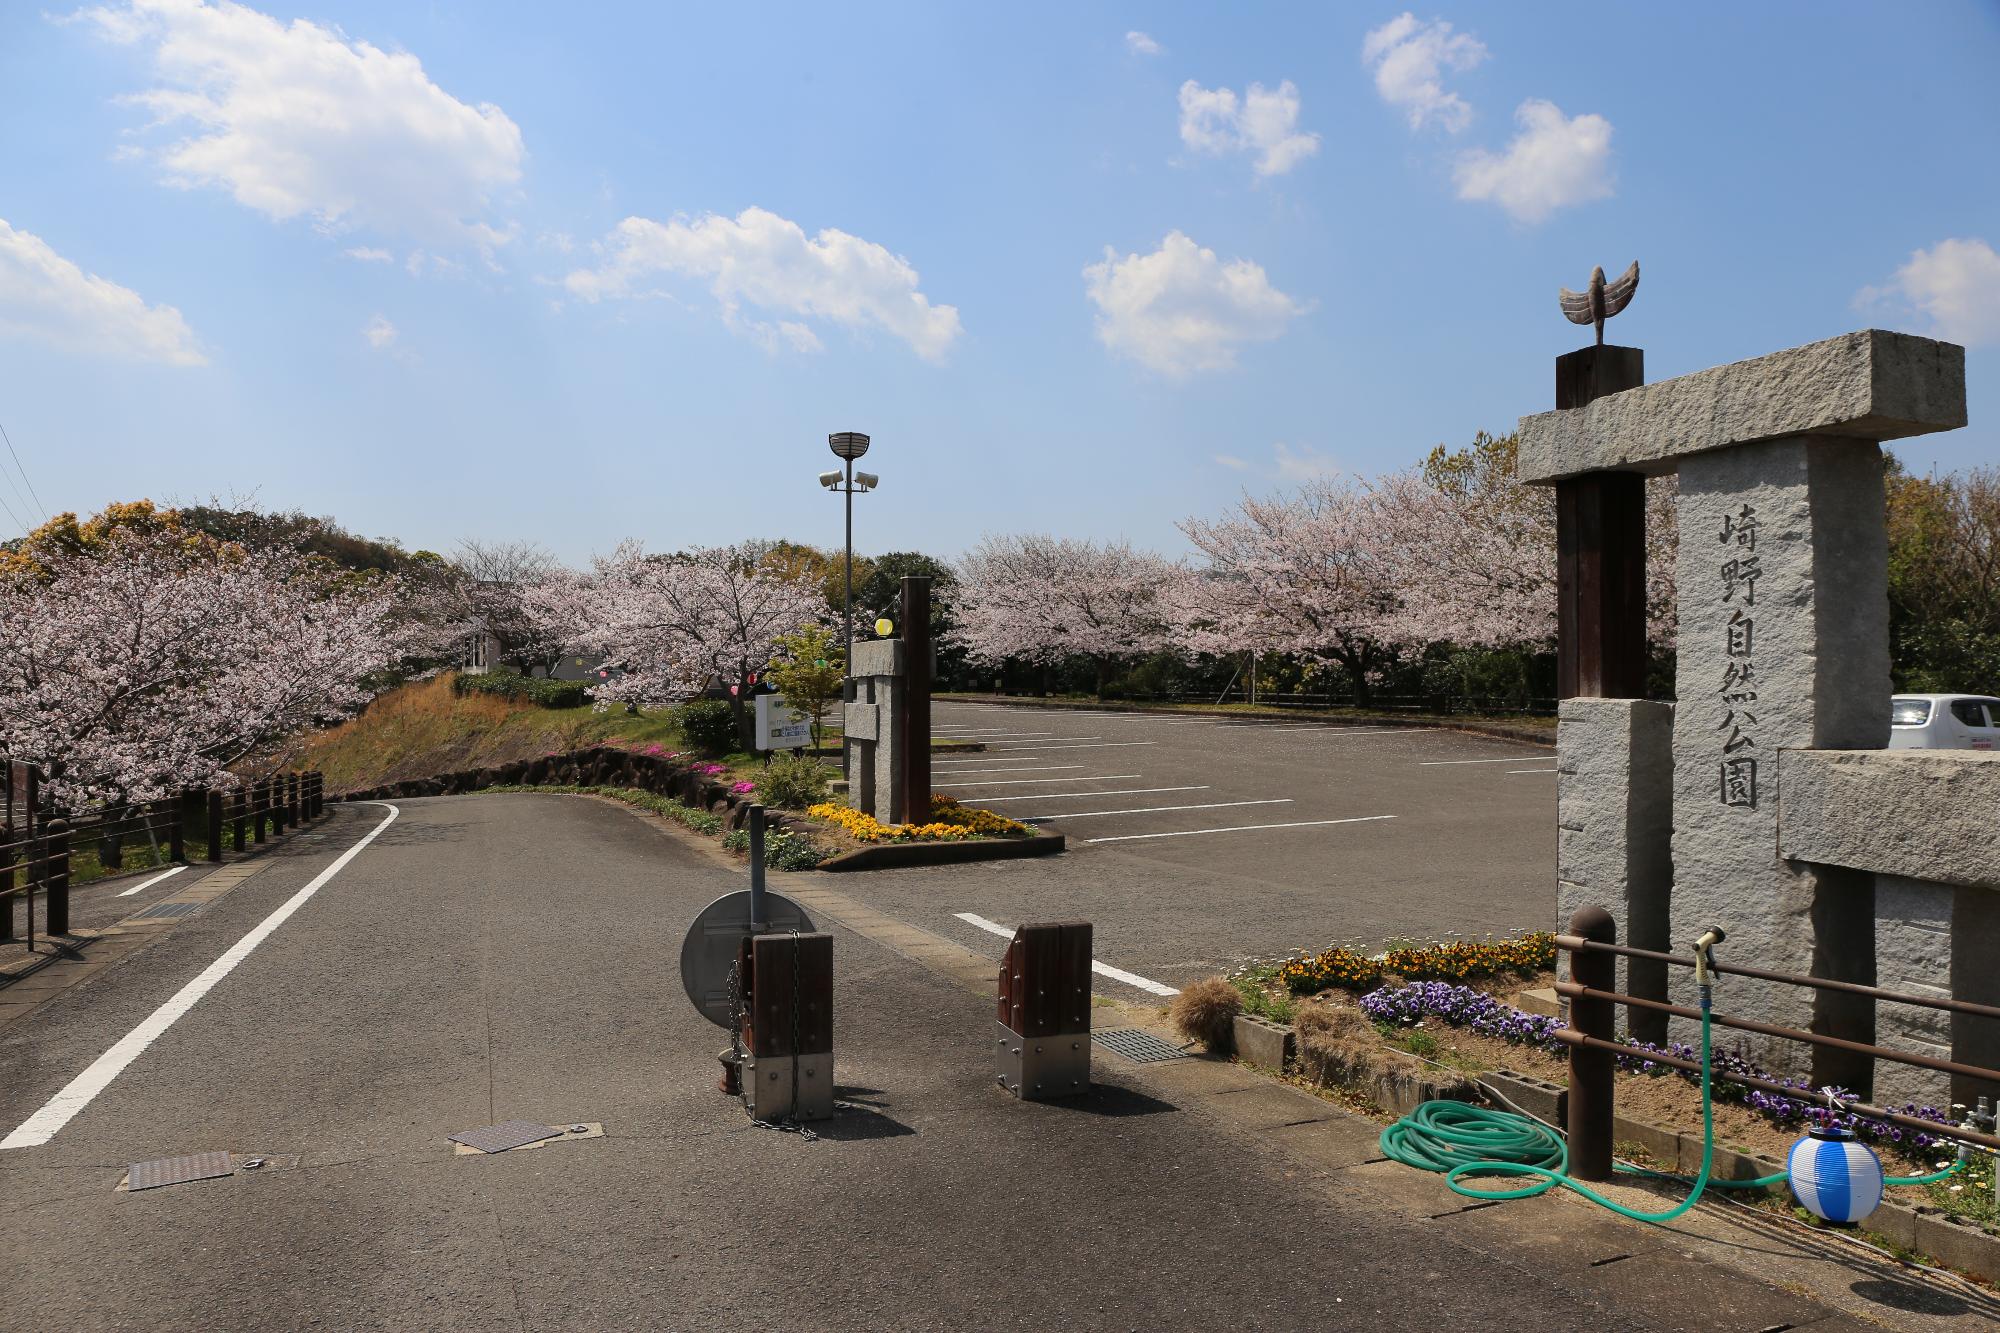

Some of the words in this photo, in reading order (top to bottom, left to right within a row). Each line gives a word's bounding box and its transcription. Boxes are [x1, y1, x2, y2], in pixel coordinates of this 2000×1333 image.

[1718, 504, 1762, 810] 崎野自然公園
